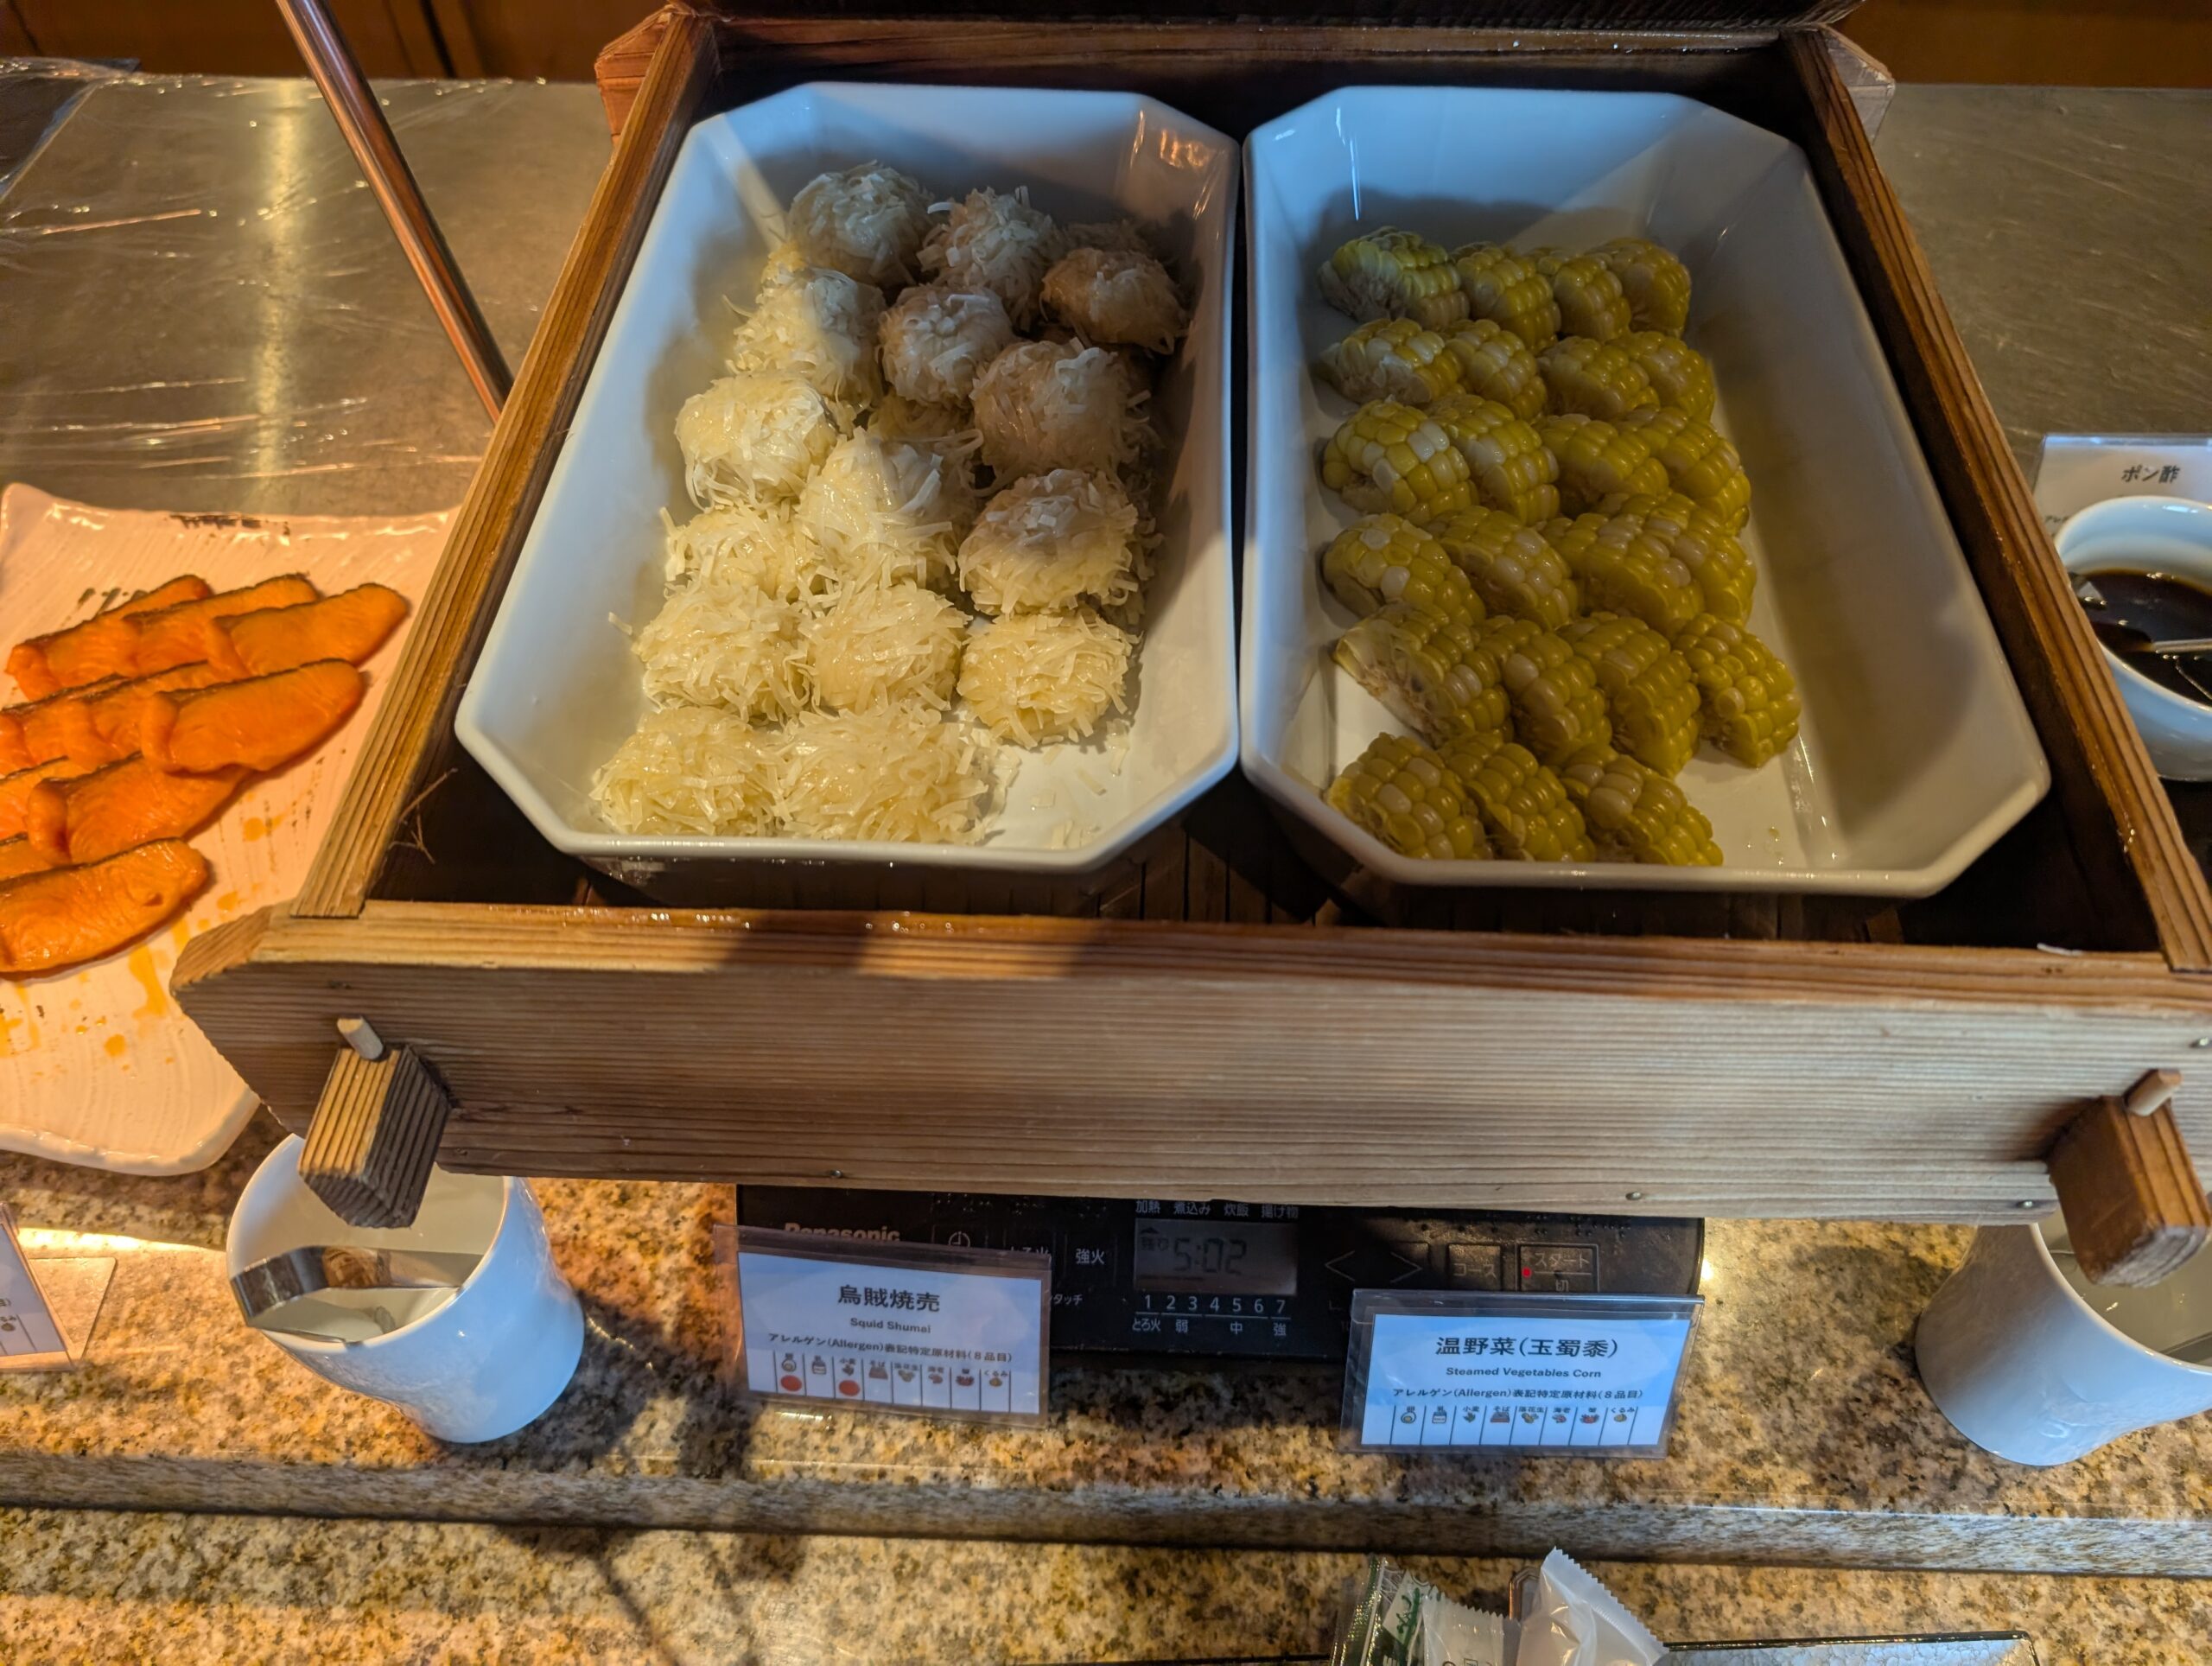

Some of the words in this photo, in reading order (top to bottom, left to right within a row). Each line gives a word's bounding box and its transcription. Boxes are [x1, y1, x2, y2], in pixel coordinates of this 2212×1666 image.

[2121, 464, 2181, 484] ポン酢
[1135, 1200, 1160, 1215] 加熱
[1173, 1202, 1211, 1217] 煮込み
[1224, 1203, 1249, 1218] 炊飯
[1076, 1248, 1105, 1265] 強火
[1173, 1237, 1248, 1275] 5:02
[1535, 1252, 1590, 1269] スタート
[1453, 1262, 1497, 1280] コース
[837, 1284, 940, 1313] 烏賊焼売
[1144, 1295, 1152, 1309] 1
[1166, 1295, 1176, 1310] 2
[1188, 1296, 1198, 1312] 3
[1210, 1297, 1220, 1313] 4
[1232, 1298, 1242, 1313] 5
[1254, 1299, 1264, 1313] 6
[1276, 1299, 1286, 1314] 7
[849, 1317, 884, 1330] Squid
[887, 1320, 931, 1334] Shumai
[1132, 1318, 1161, 1332] とろ火
[1175, 1319, 1189, 1333] 弱
[1230, 1321, 1243, 1335] 中
[1273, 1322, 1287, 1337] 強
[1446, 1366, 1499, 1377] Steamed
[1503, 1367, 1569, 1378] Vegetables
[1573, 1369, 1602, 1378] Corn
